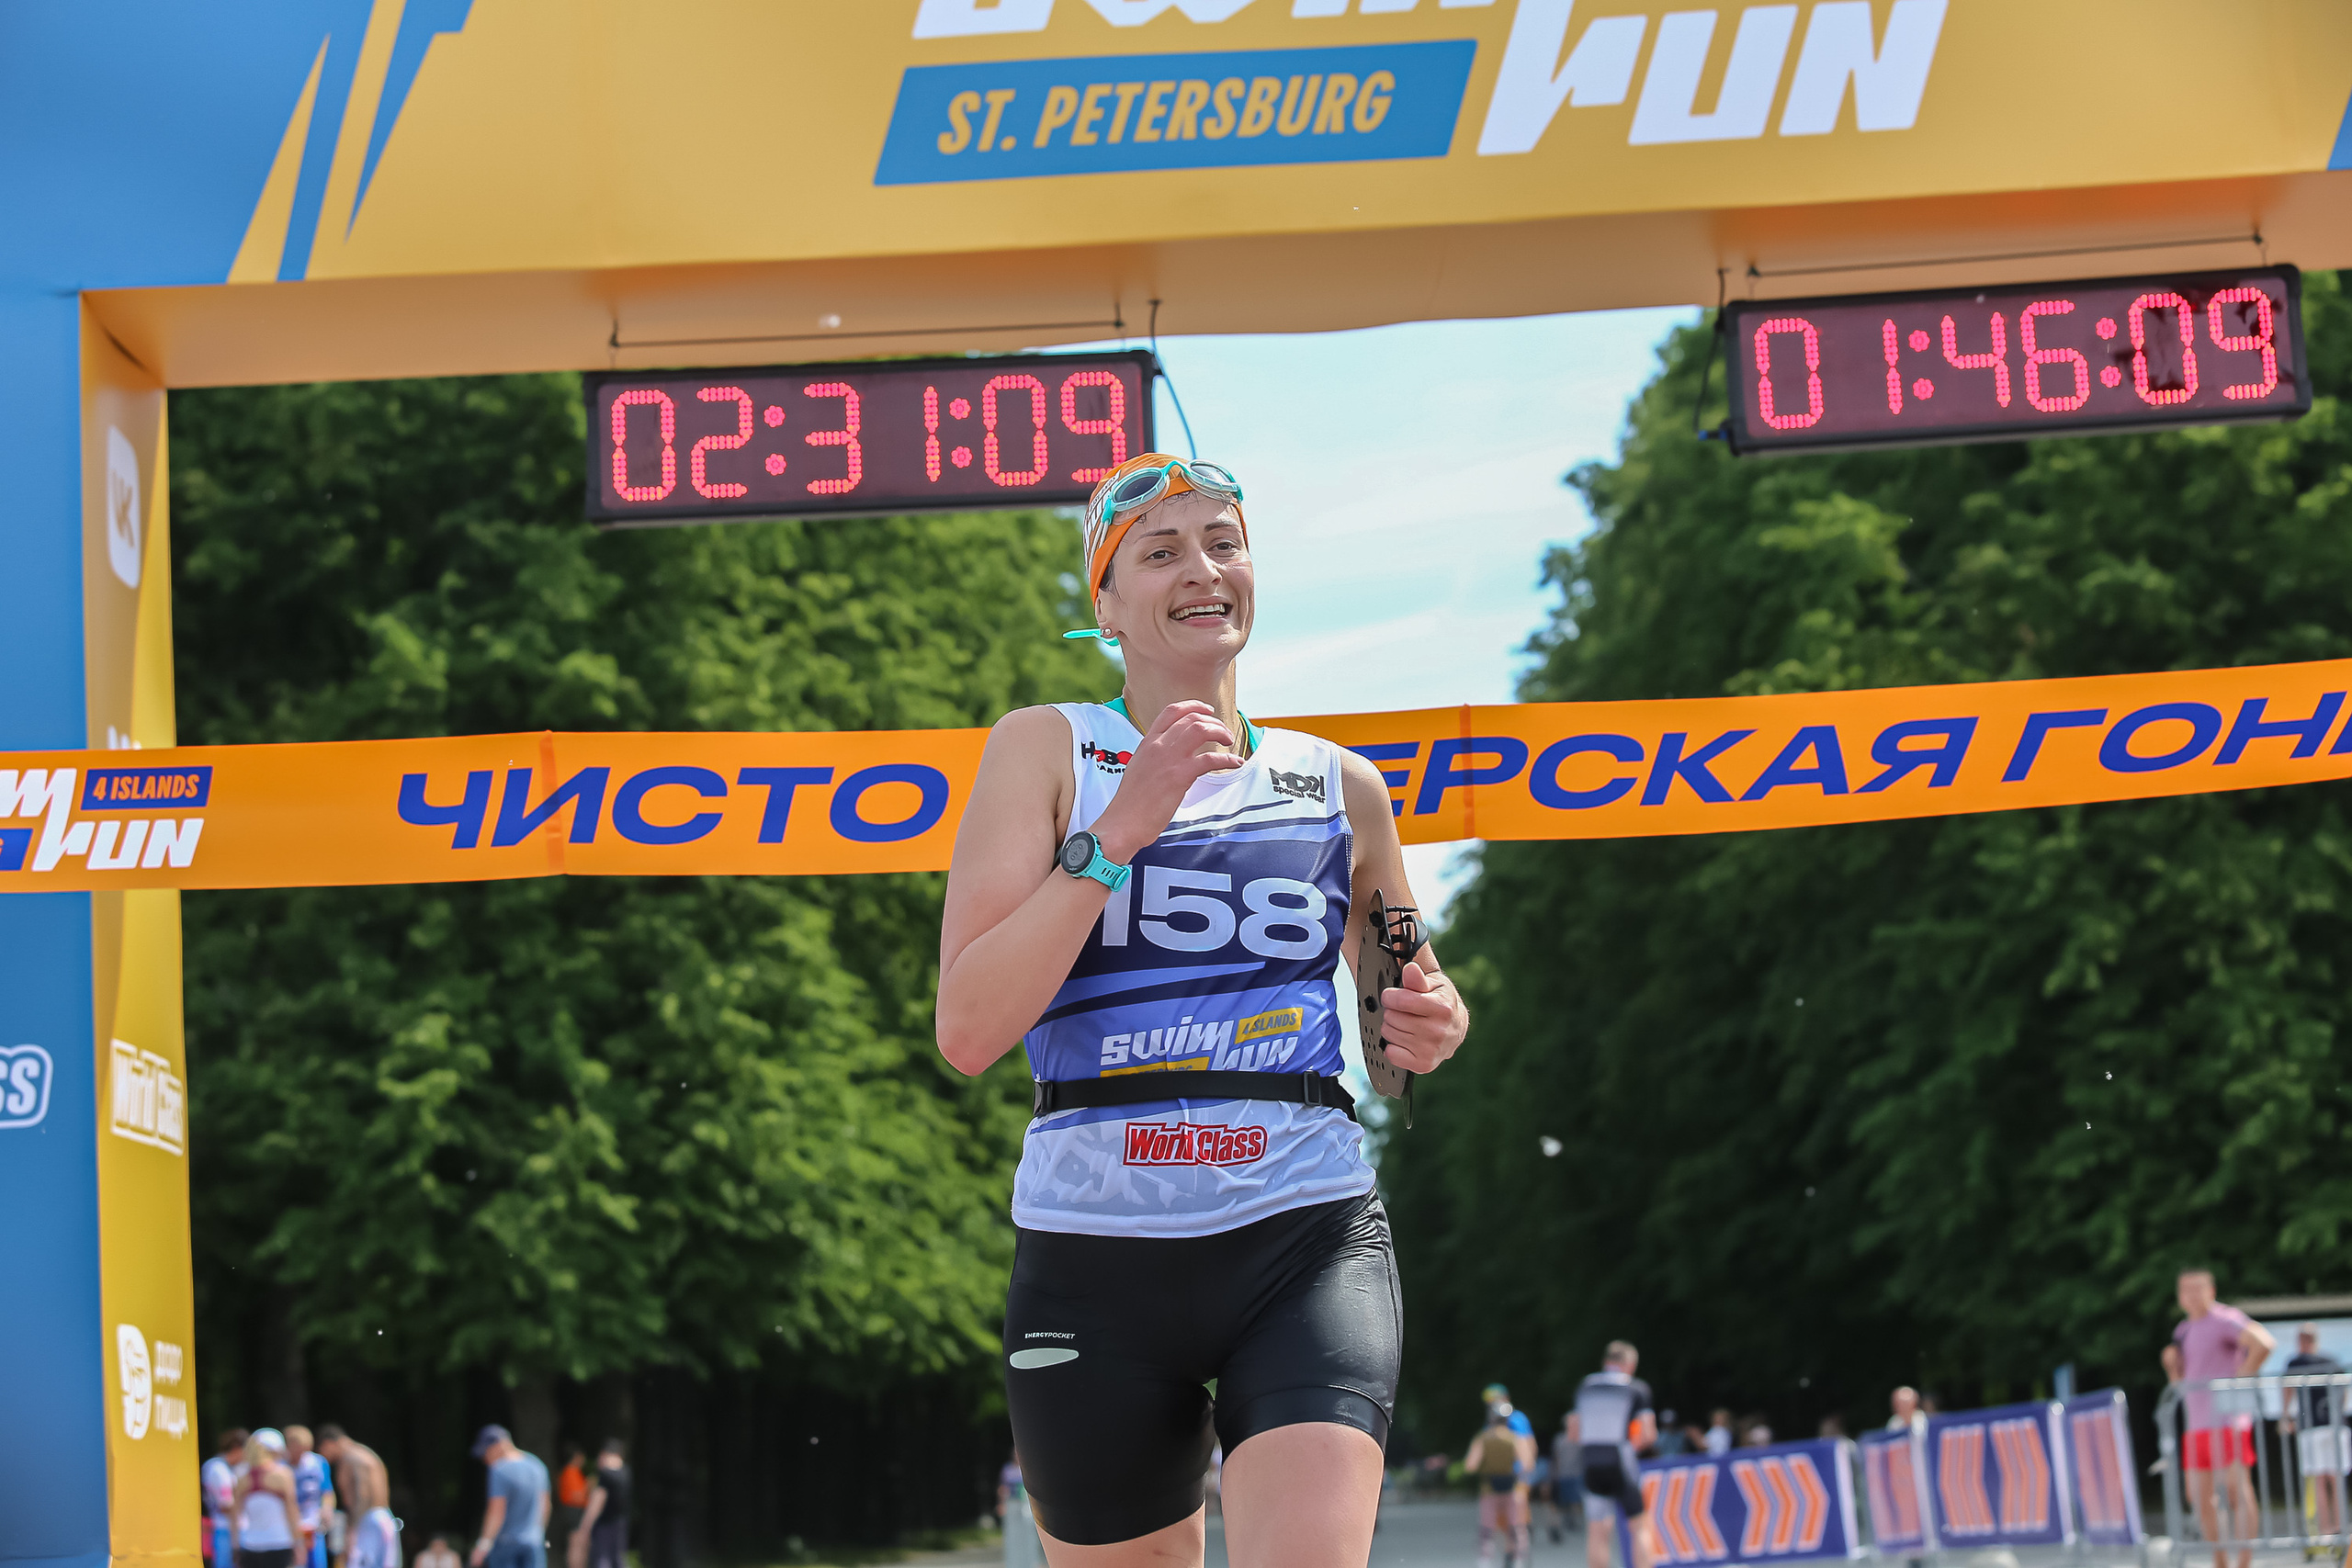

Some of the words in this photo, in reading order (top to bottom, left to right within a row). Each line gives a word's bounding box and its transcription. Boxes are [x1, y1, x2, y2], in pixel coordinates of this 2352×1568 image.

[937, 89, 1017, 154] ST.
[1033, 71, 1396, 149] PETERSBURG
[1754, 287, 2278, 430] 01:46:09
[611, 370, 1127, 502] 02:31:09
[93, 777, 107, 800] 4
[110, 774, 200, 800] ISLANDS
[397, 763, 950, 850] ЧИСТО
[1345, 716, 1980, 818] ЕРСКАЯ
[2000, 691, 2352, 784] ГОН
[1272, 785, 1306, 799] special
[1306, 792, 1326, 804] wear
[1102, 864, 1329, 961] 158
[1197, 1130, 1262, 1162] Class
